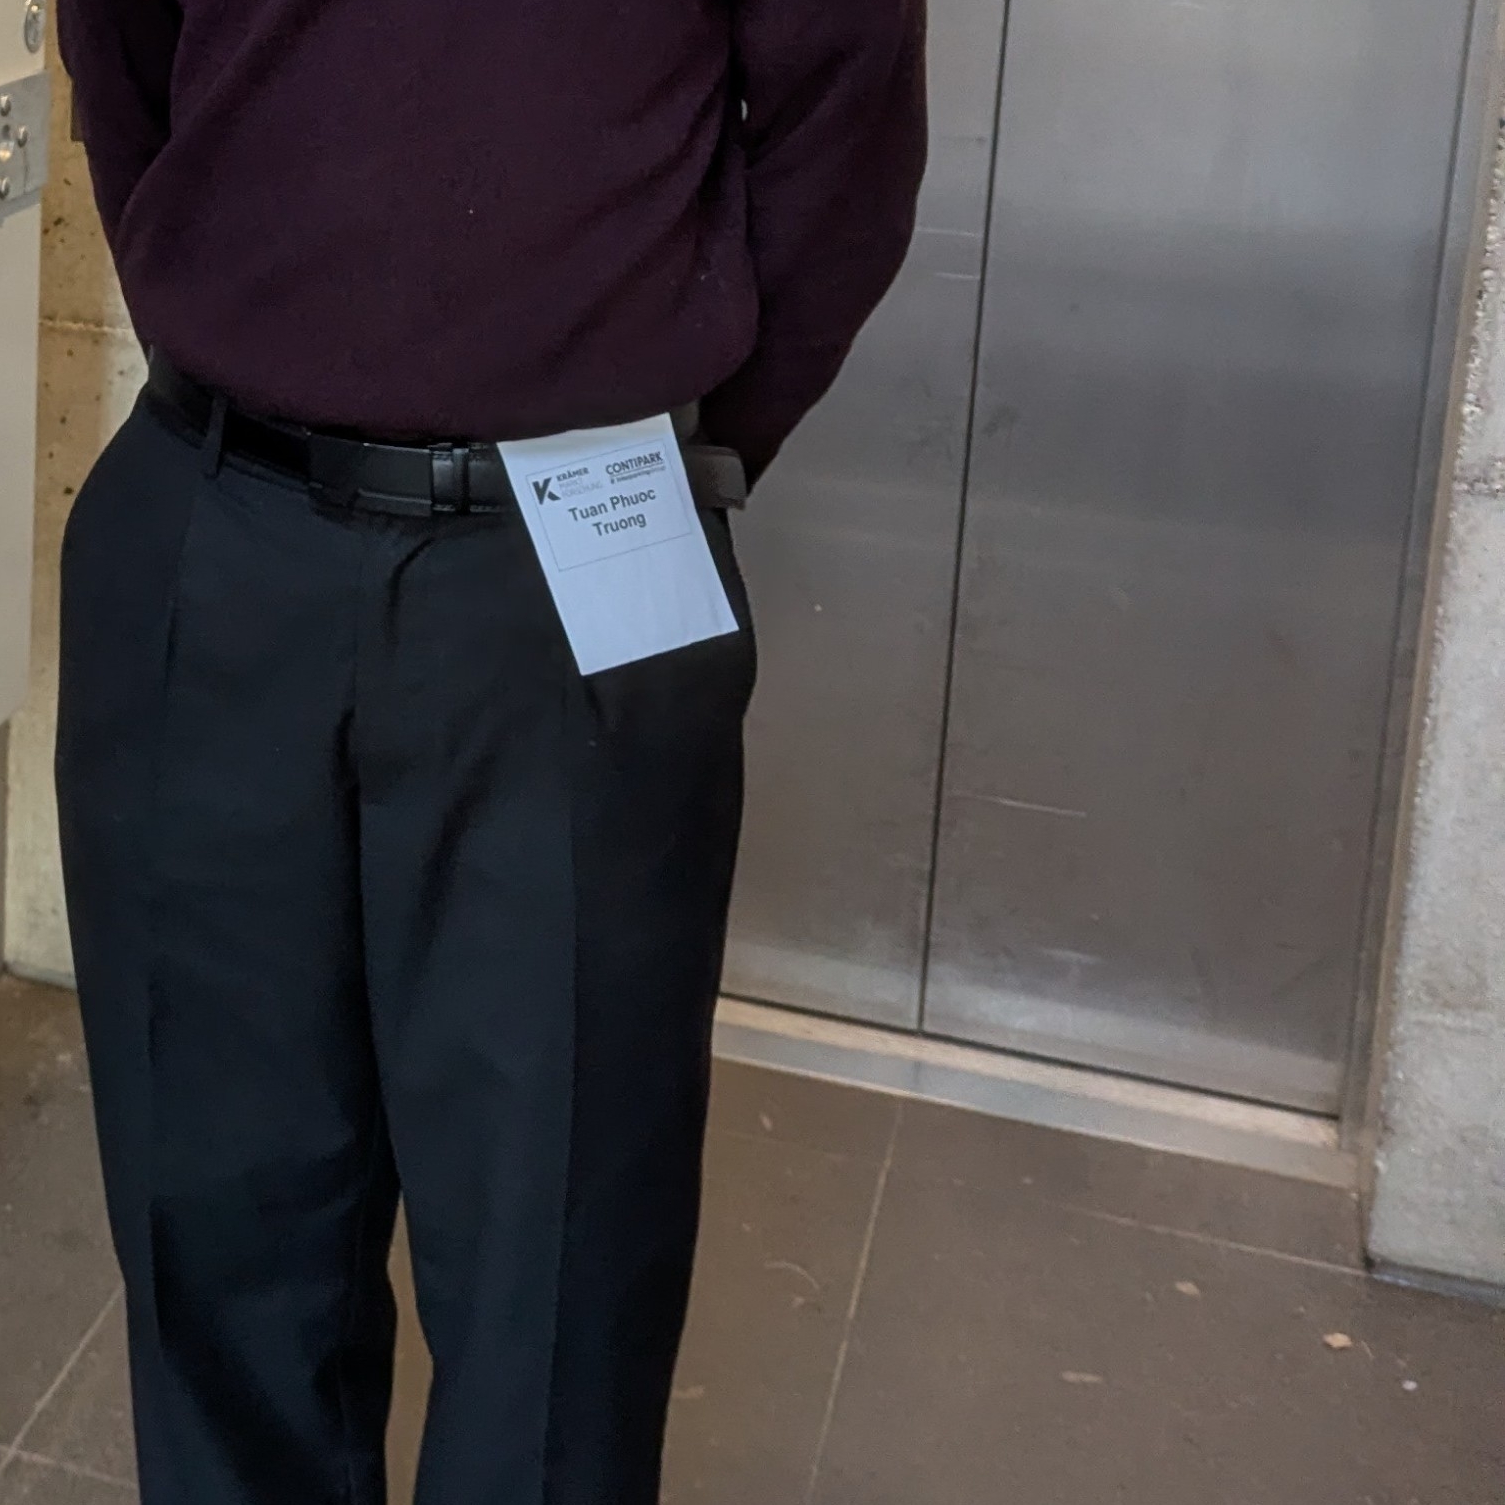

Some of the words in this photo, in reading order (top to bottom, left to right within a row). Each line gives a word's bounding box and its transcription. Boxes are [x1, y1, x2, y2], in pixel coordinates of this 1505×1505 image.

[556, 467, 589, 482] KRÄMER
[605, 451, 663, 475] CONTIPARK
[568, 502, 608, 522] Tuan
[609, 489, 656, 511] Phuoc
[592, 514, 647, 536] Truong
